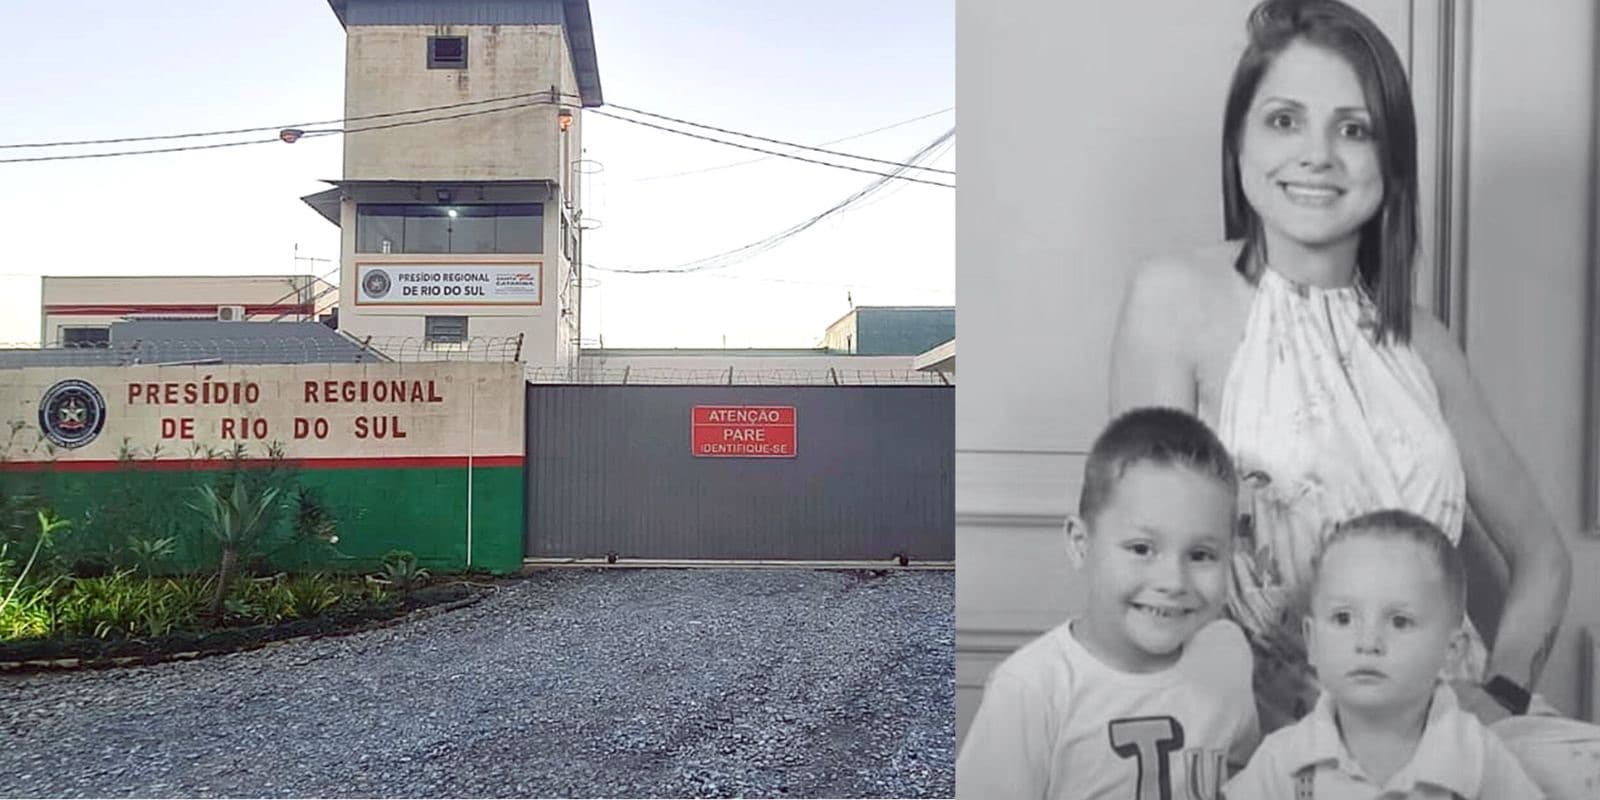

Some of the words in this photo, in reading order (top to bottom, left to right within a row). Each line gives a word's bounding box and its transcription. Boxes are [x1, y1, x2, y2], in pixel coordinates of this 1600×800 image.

[398, 271, 441, 282] PRESÍDIO
[443, 273, 490, 282] REGIONAL
[403, 286, 417, 296] DE
[421, 286, 441, 296] RIO
[444, 286, 462, 296] DO
[464, 286, 485, 296] SUL
[128, 375, 260, 404] PRESÍDIO
[304, 380, 443, 404] REGIONAL
[162, 417, 194, 439] DE
[221, 417, 268, 439] RIO
[294, 417, 329, 439] DO
[355, 416, 407, 438] SUL
[723, 428, 766, 441] PARE
[701, 444, 788, 453] IDENTIFIQUE-SE
